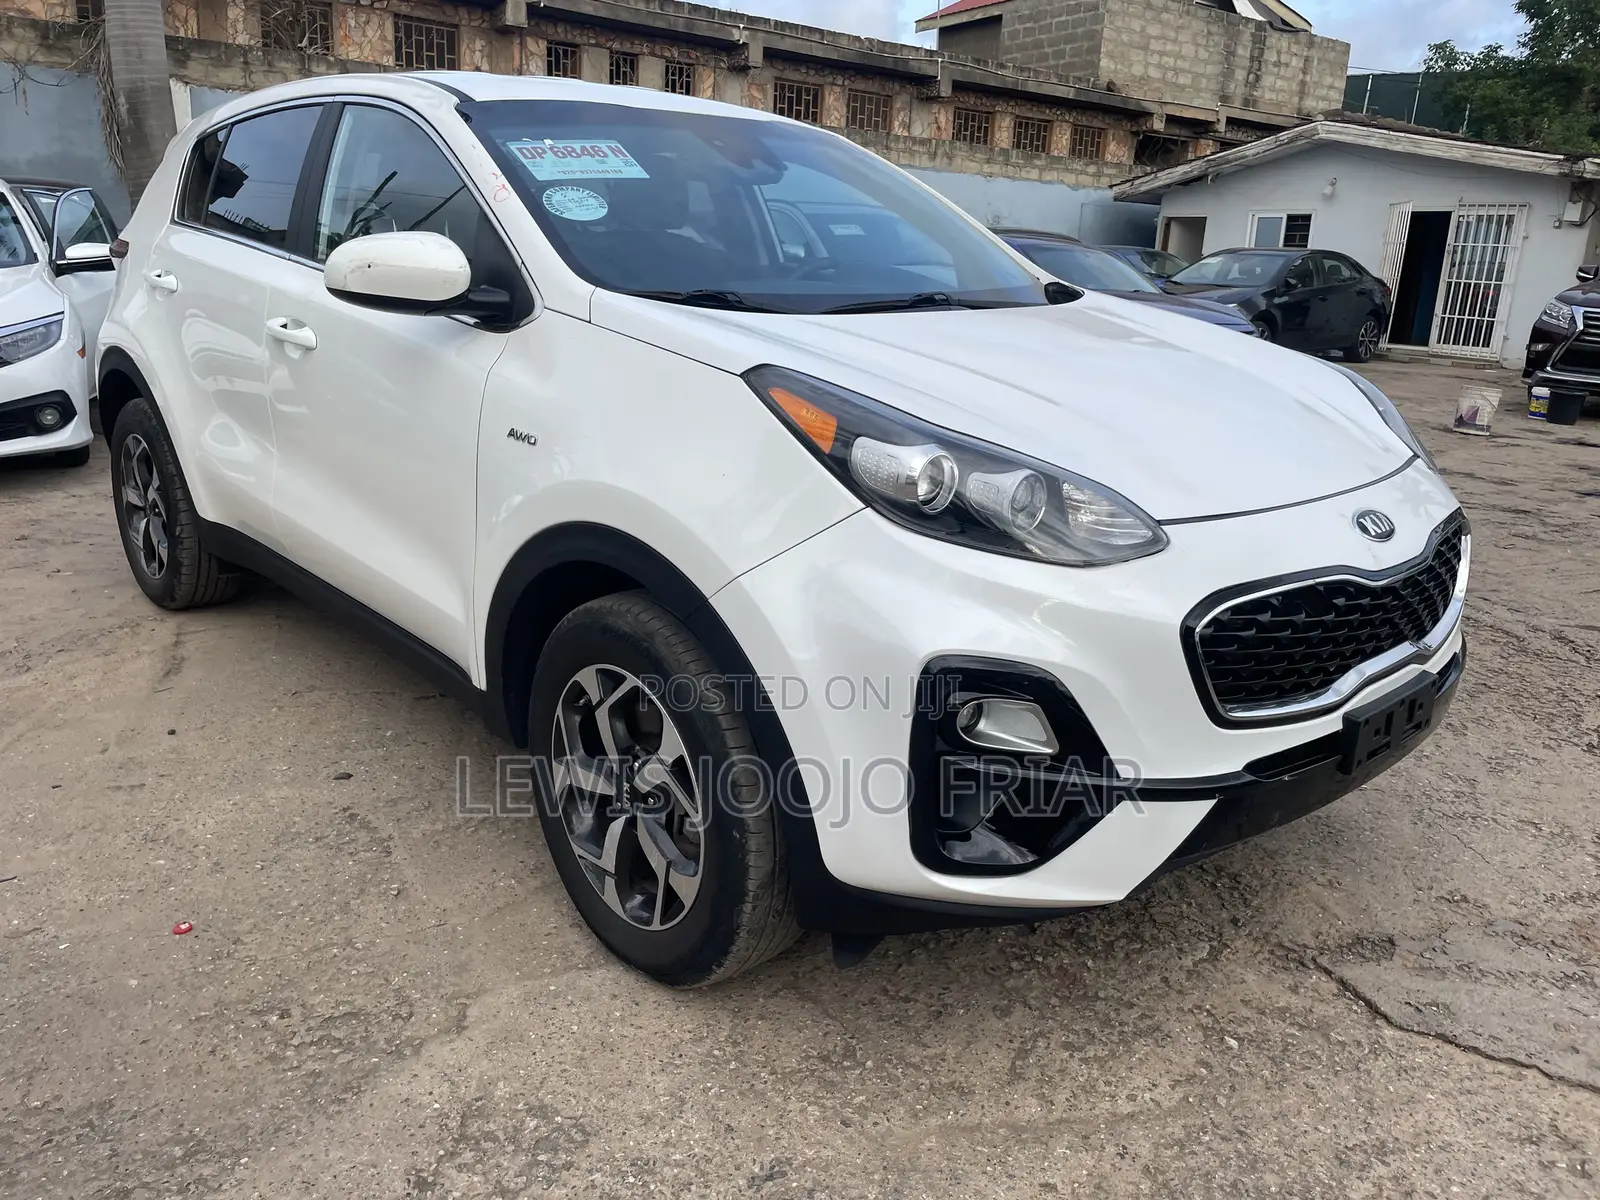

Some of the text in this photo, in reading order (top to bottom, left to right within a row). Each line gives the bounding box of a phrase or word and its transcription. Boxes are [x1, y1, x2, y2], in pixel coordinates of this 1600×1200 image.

[515, 144, 629, 160] DP 6846 N
[506, 427, 537, 446] AWD
[1358, 512, 1394, 536] KIA
